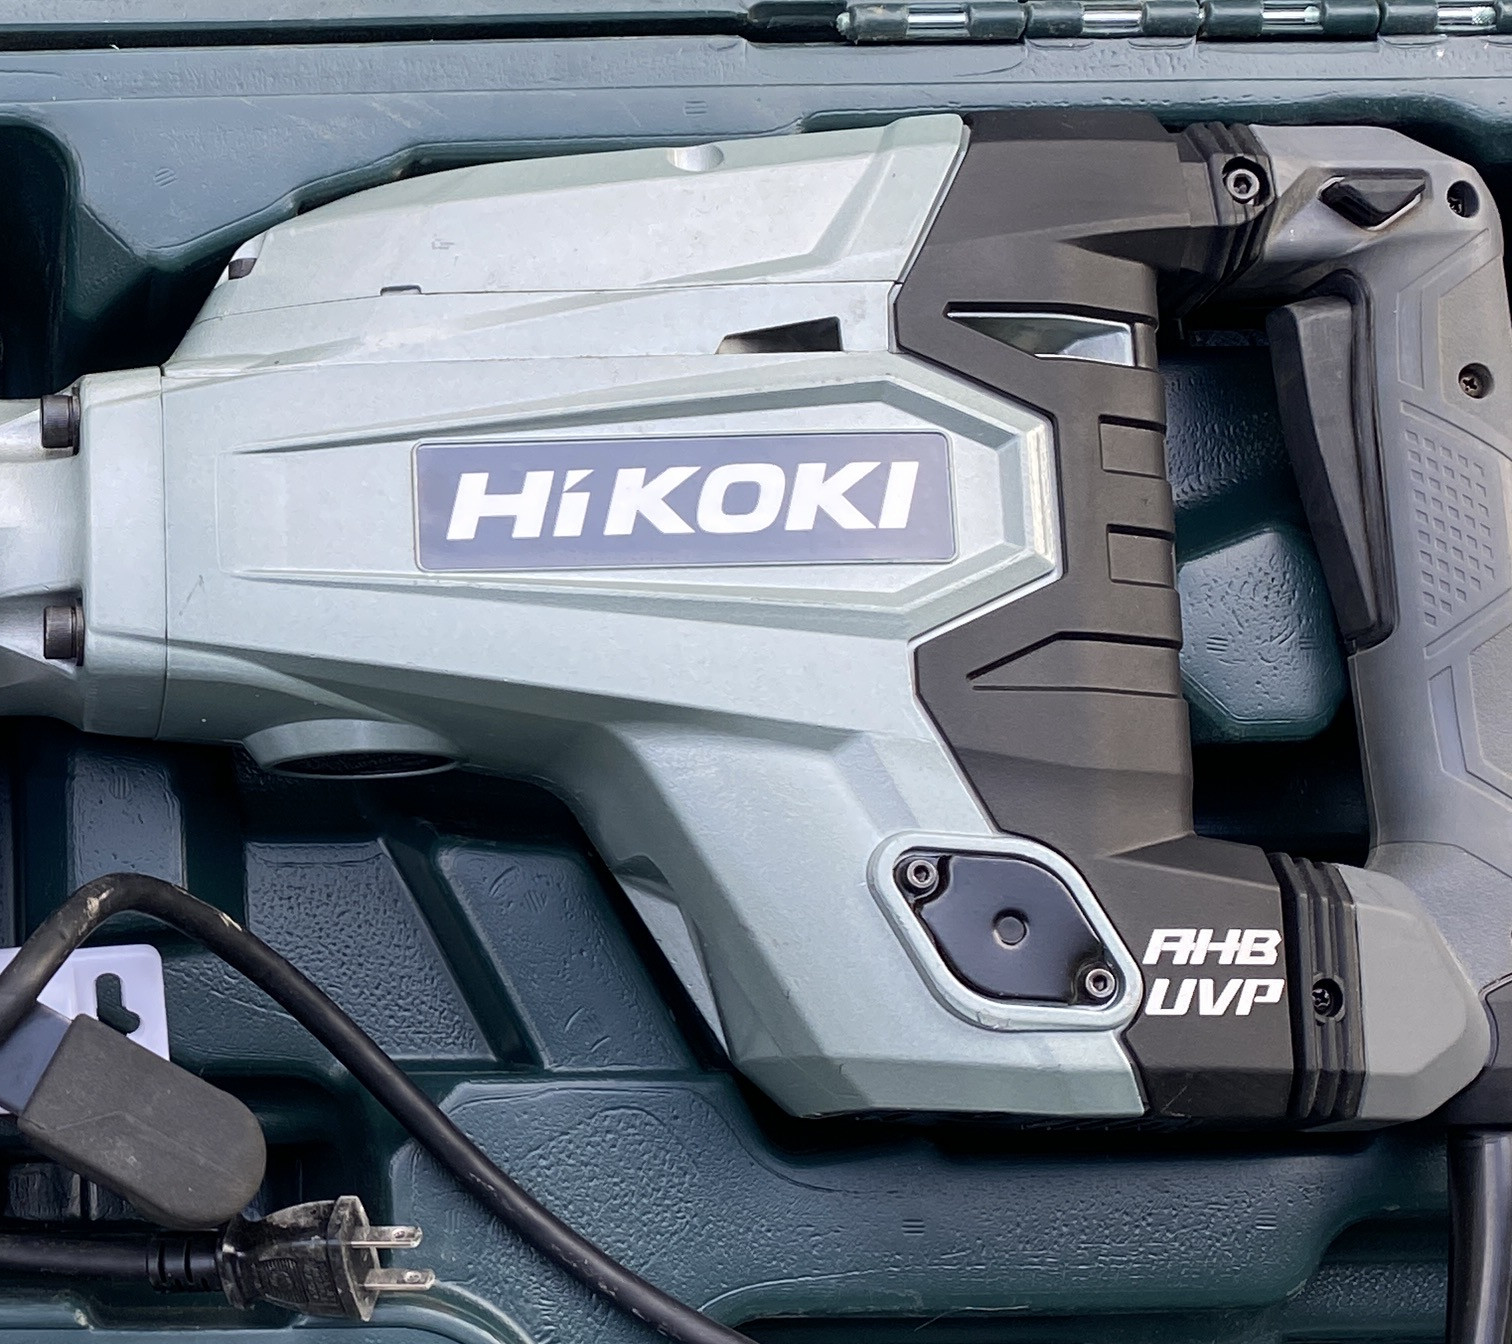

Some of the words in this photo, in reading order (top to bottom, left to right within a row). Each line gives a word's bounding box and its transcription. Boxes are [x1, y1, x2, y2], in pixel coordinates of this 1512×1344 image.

[446, 461, 920, 540] HiKOKI
[1142, 928, 1282, 965] AHB
[1144, 978, 1285, 1016] UVP
